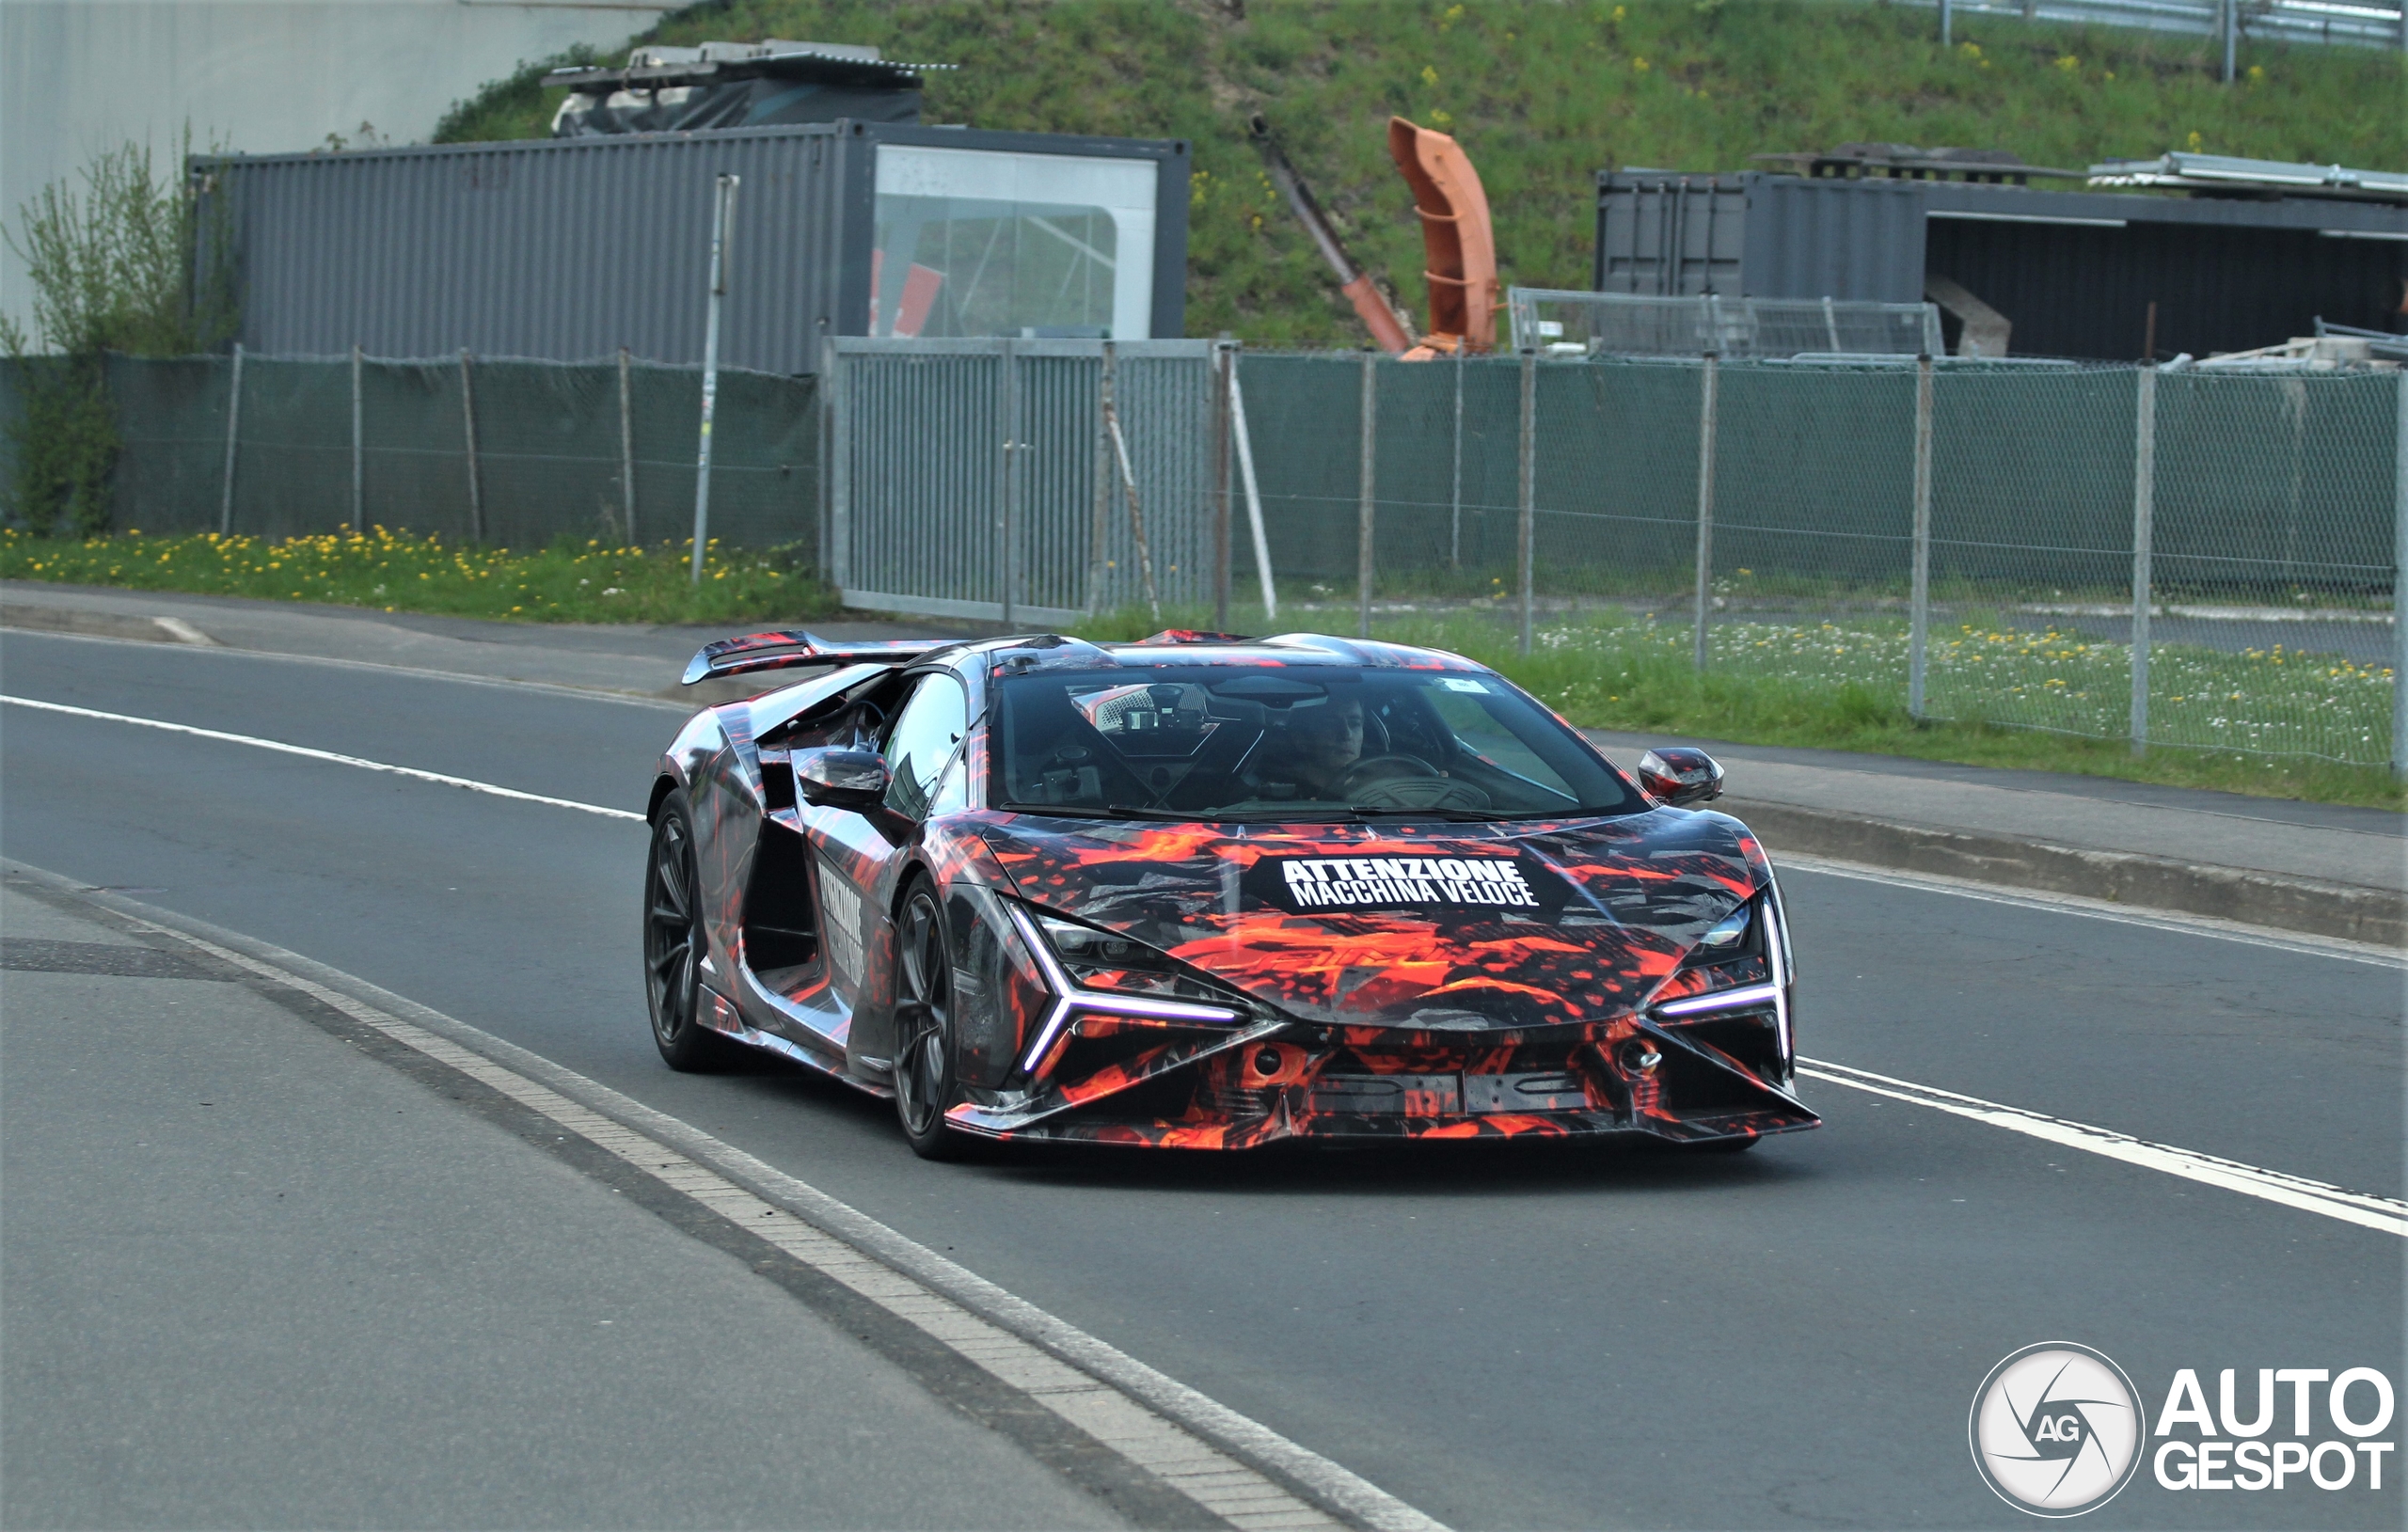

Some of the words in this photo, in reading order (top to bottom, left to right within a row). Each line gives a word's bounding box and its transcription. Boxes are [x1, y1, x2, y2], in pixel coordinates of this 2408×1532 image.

[1282, 858, 1527, 884] ATTENZIONE
[1288, 878, 1442, 907] MACCHINA
[1440, 879, 1540, 907] VELOCE
